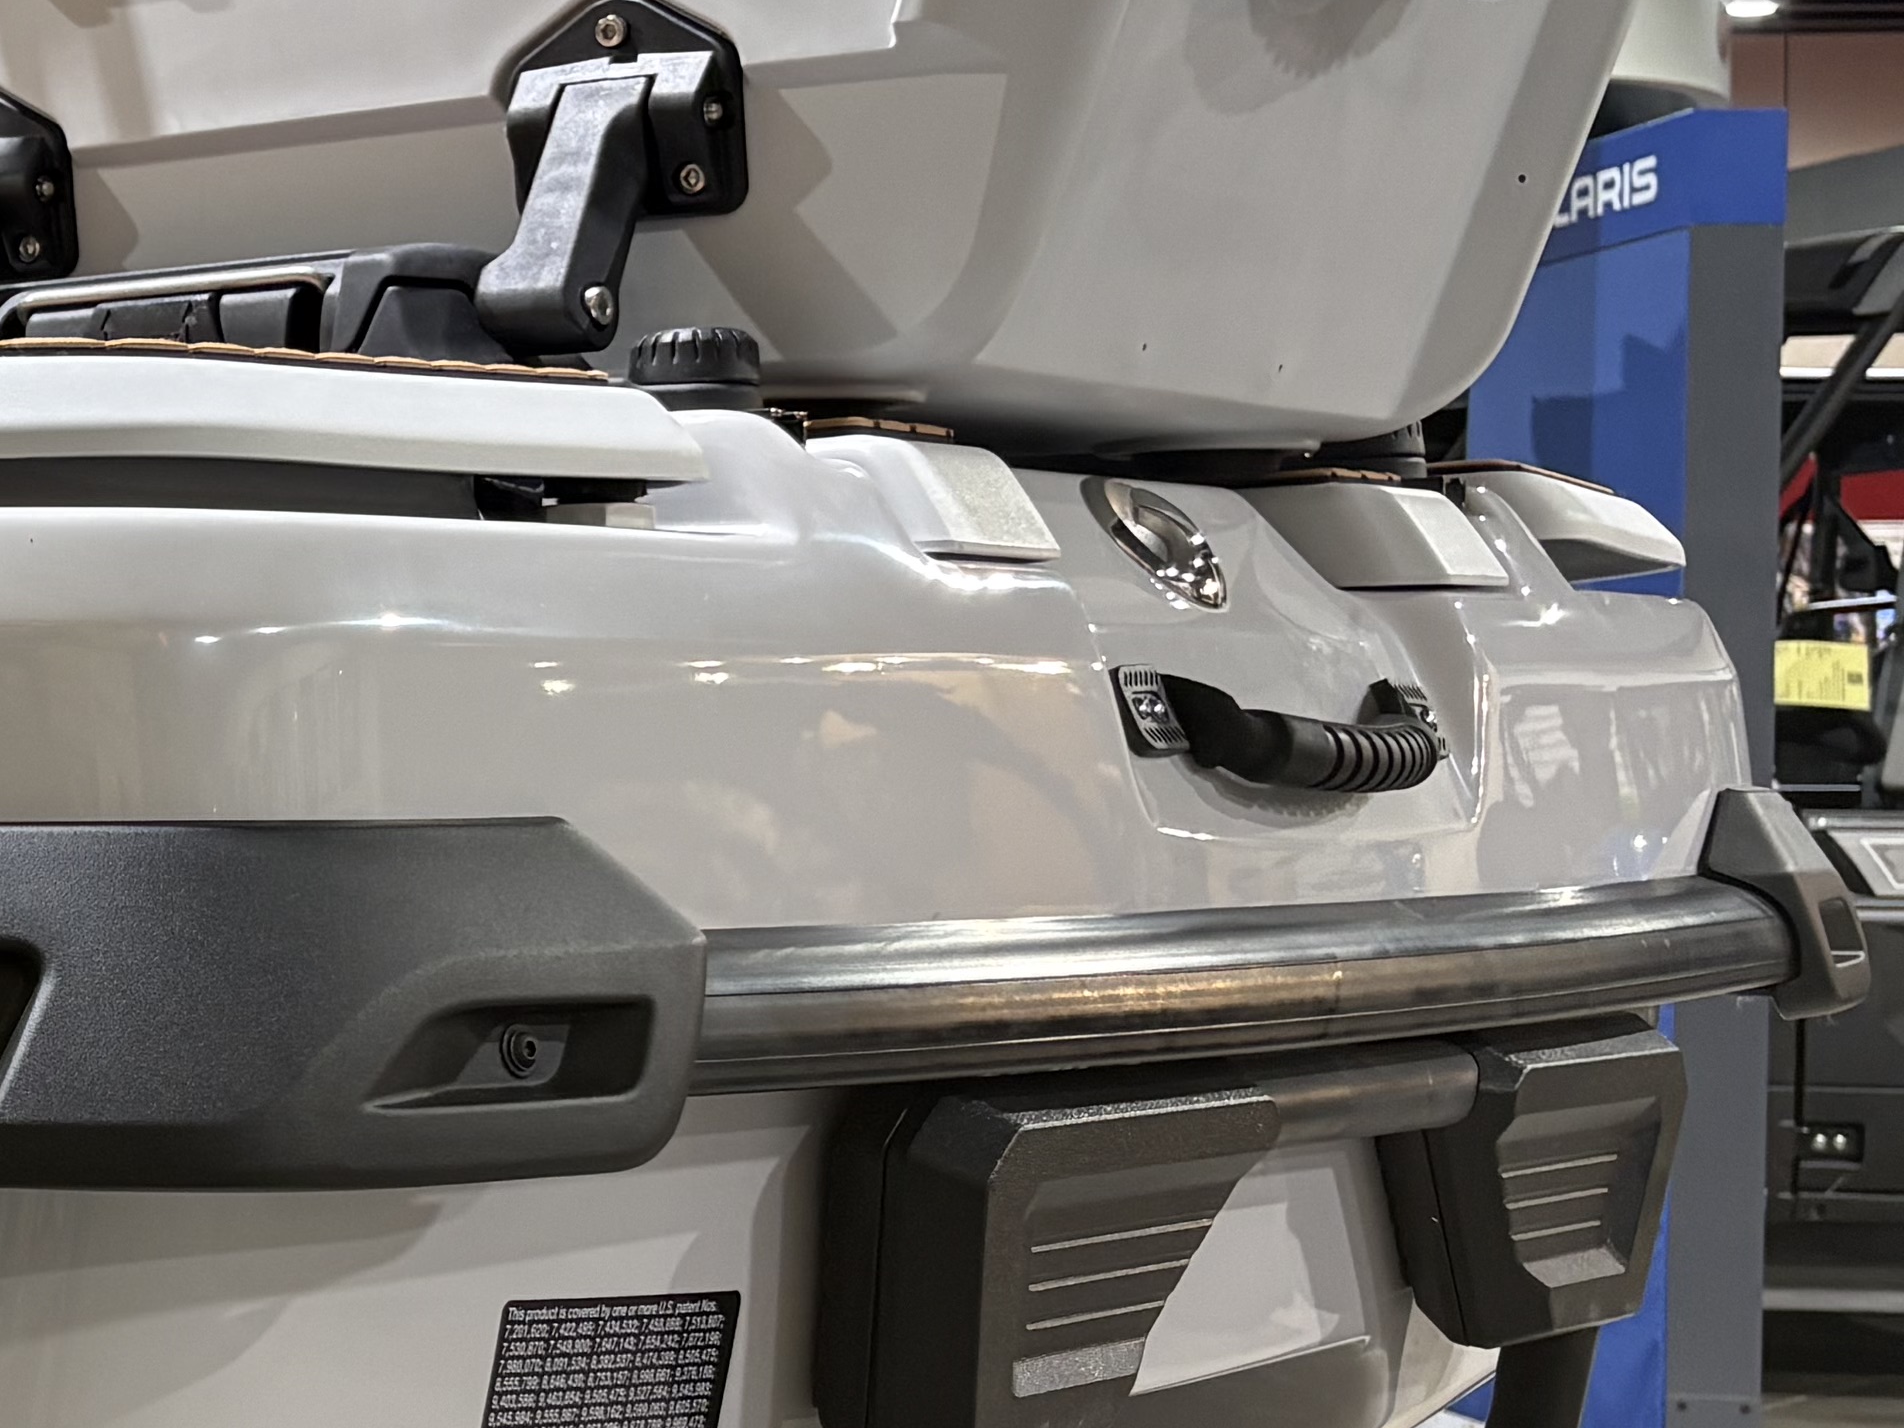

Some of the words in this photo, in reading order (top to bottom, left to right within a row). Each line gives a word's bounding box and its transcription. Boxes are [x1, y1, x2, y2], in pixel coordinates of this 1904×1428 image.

[1554, 155, 1658, 228] ARIS
[506, 1307, 525, 1321] This
[525, 1306, 558, 1322] product
[558, 1306, 567, 1319] is
[567, 1304, 600, 1319] covered
[599, 1303, 611, 1319] by
[611, 1305, 627, 1317] one
[627, 1304, 637, 1315] or
[674, 1300, 701, 1314] patent
